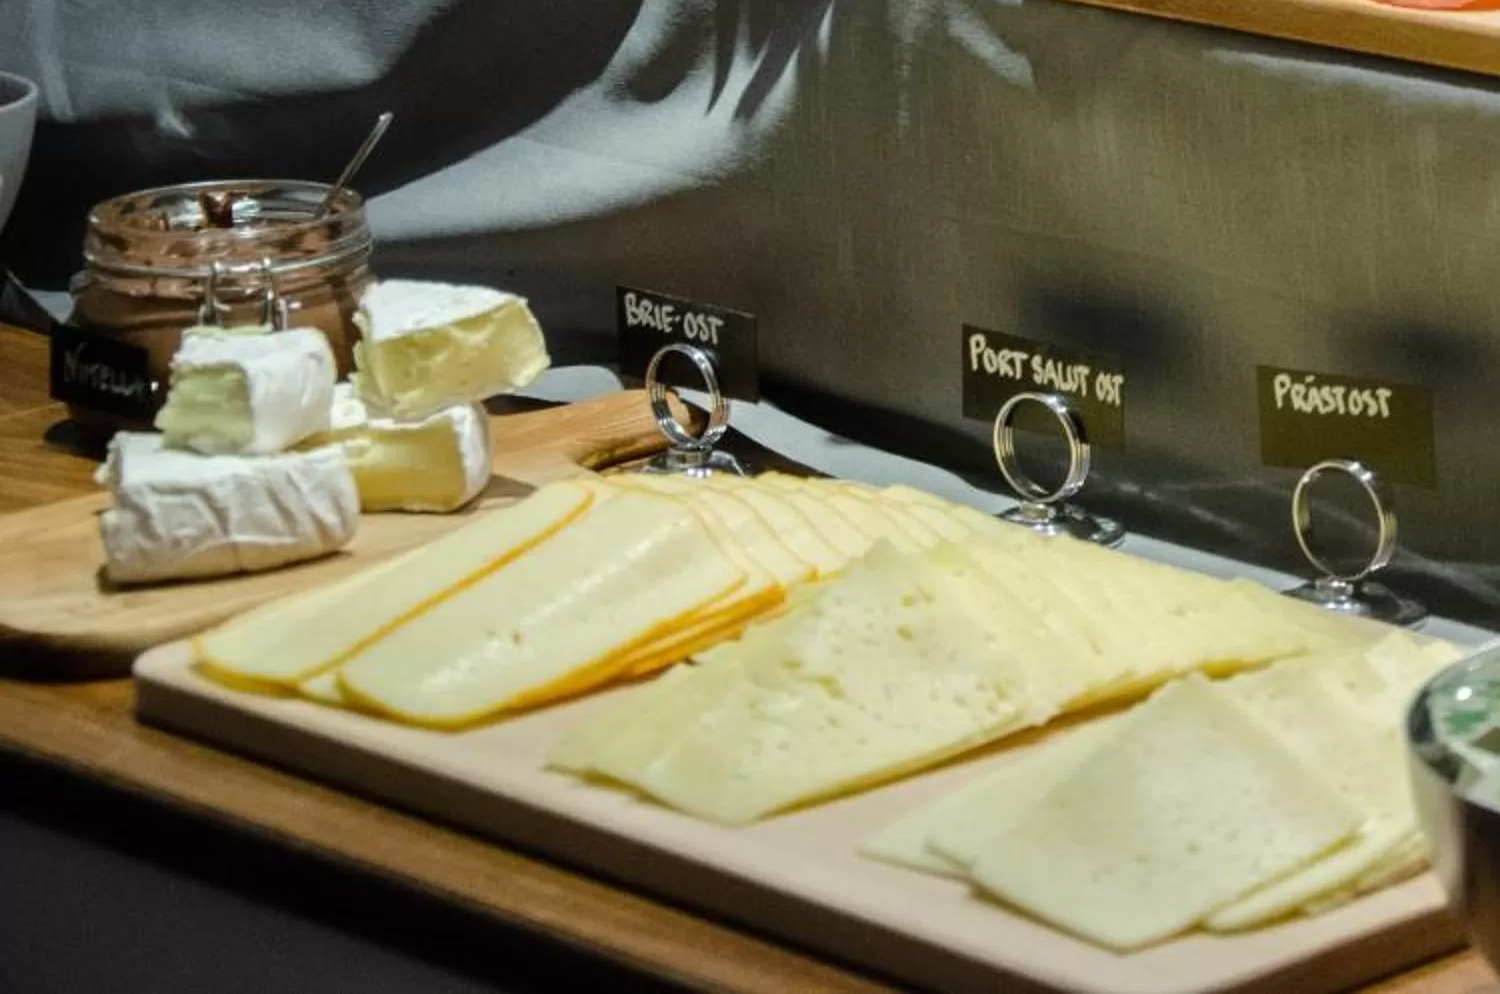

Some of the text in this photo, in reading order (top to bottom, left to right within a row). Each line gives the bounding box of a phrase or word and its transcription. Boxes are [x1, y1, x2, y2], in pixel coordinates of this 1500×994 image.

[968, 333, 1125, 406] PORT SALUT OST
